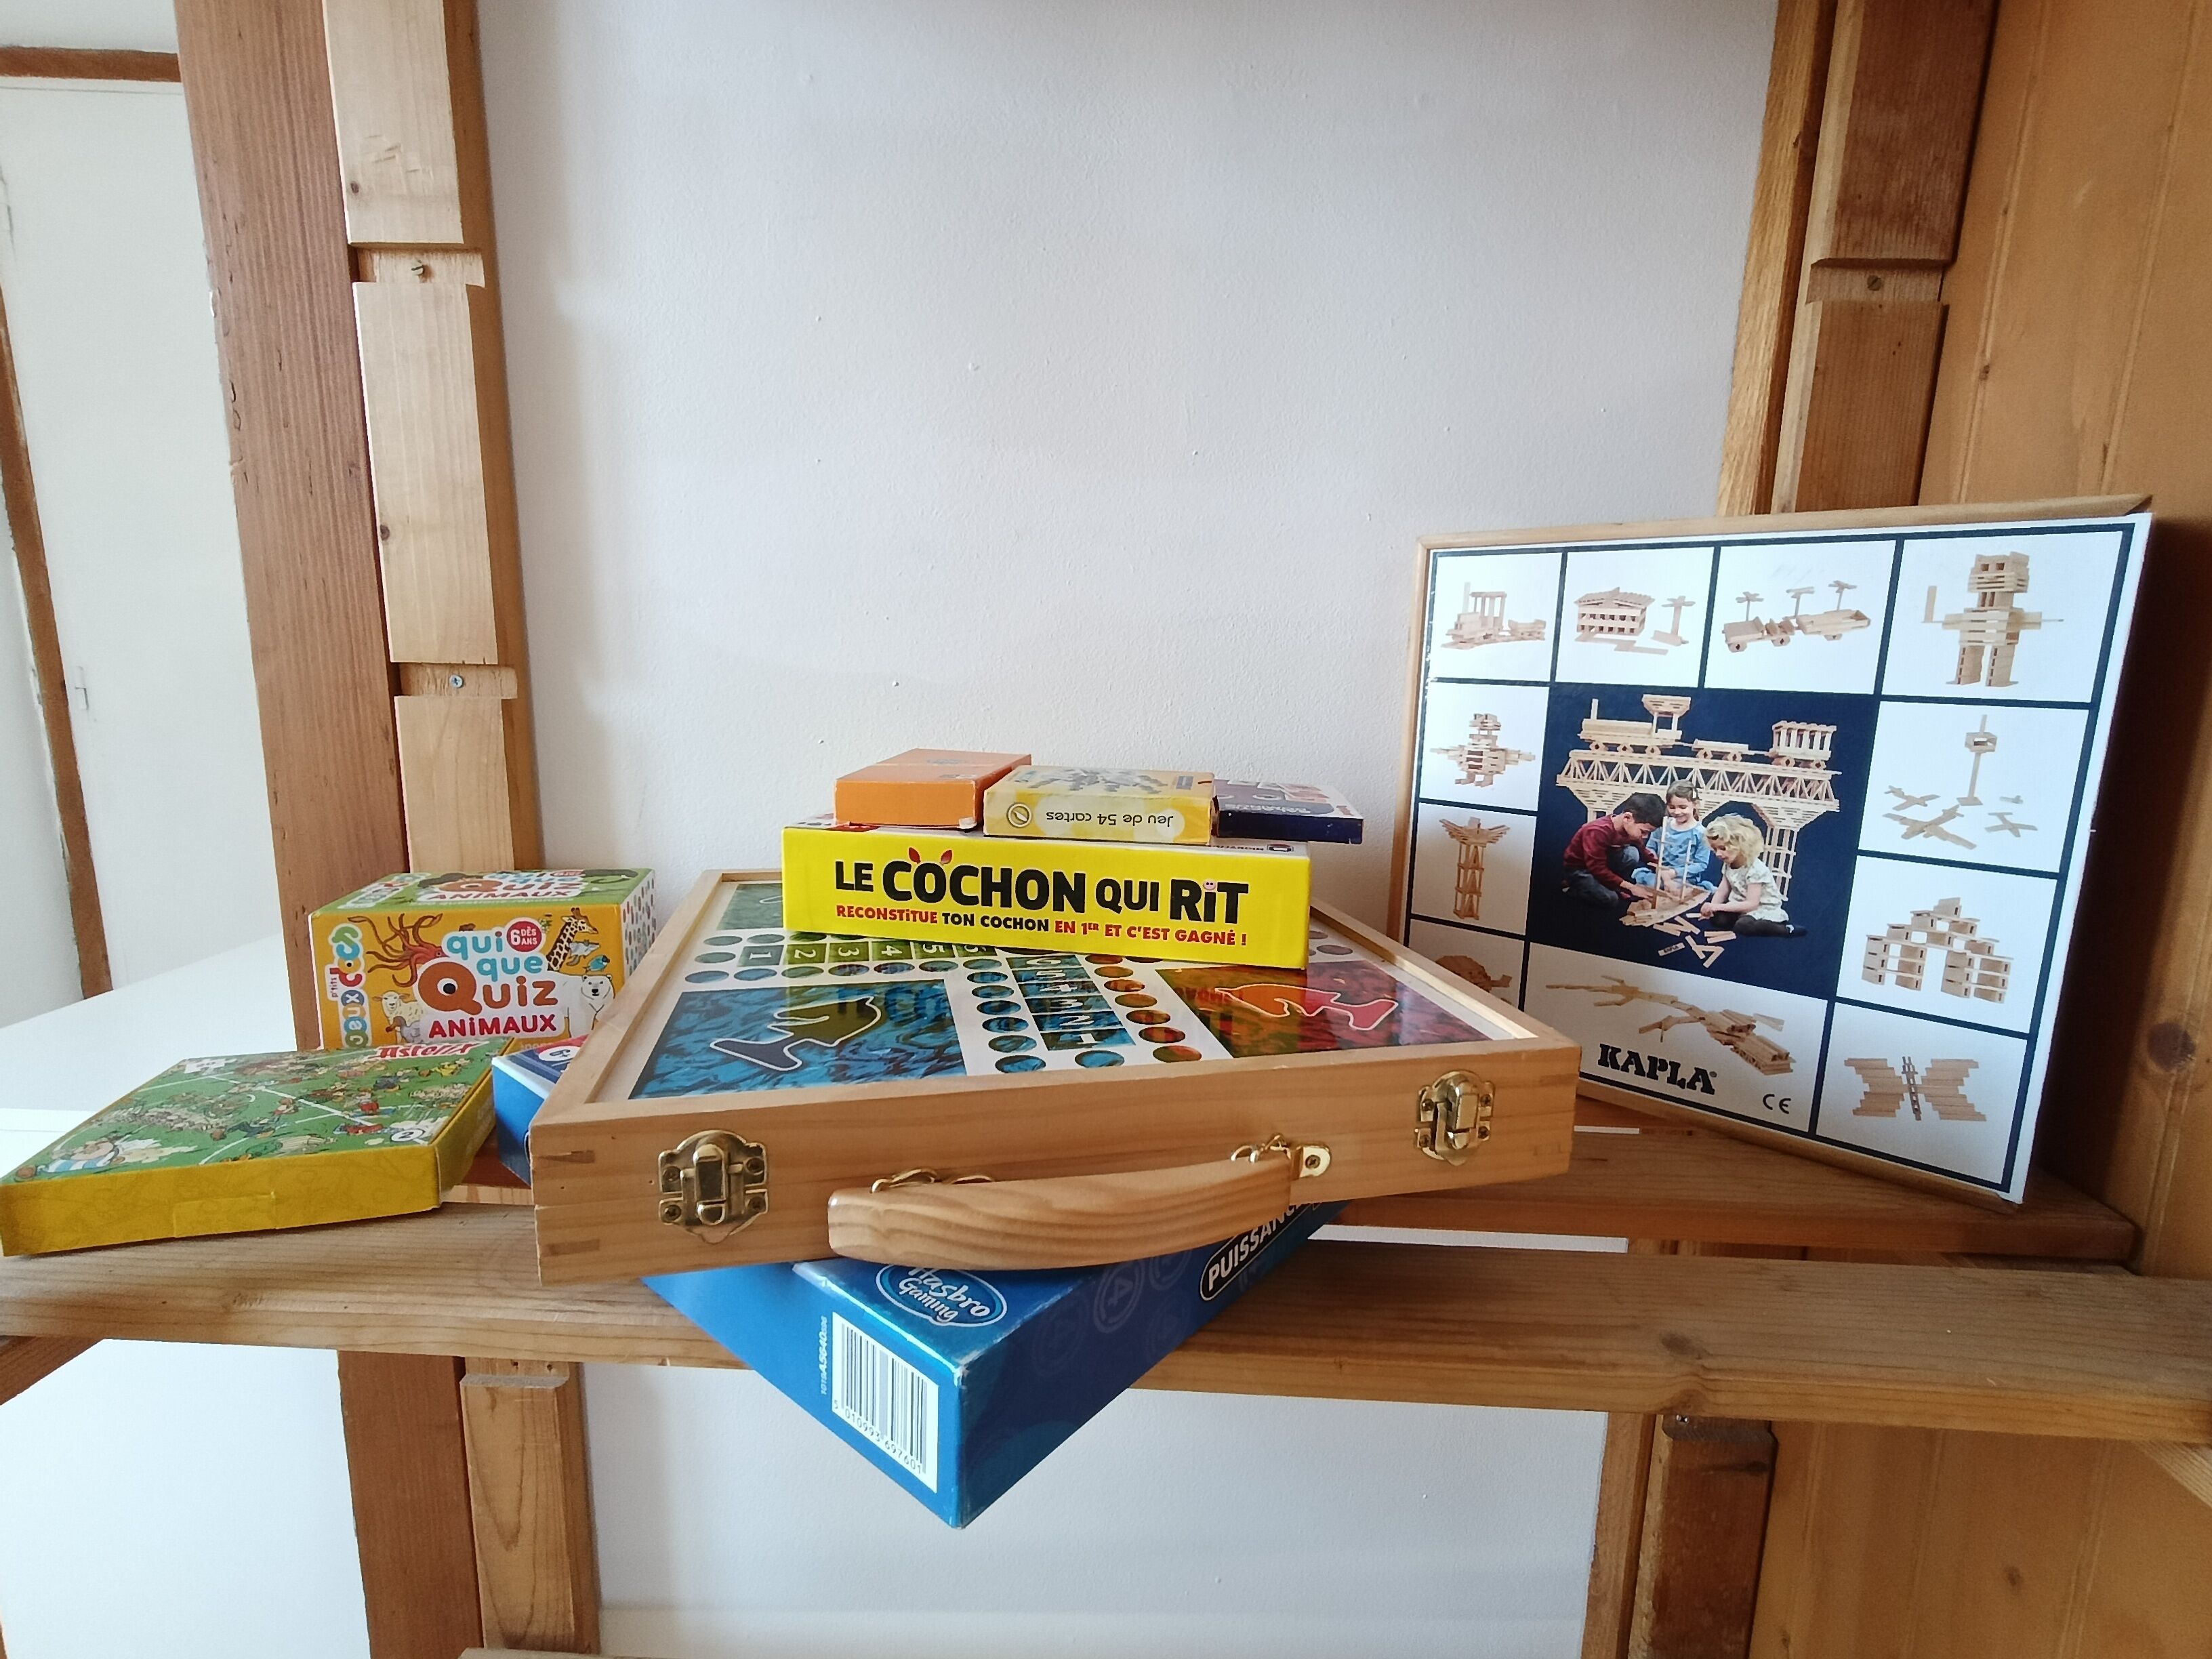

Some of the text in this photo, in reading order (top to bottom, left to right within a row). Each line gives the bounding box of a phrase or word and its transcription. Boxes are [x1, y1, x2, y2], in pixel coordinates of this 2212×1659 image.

[1046, 811, 1174, 827] Jeu de 54 cartes
[835, 861, 874, 892] LE
[882, 860, 1086, 914] COCHON
[1095, 878, 1160, 914] QUI
[510, 929, 520, 945] 6
[520, 926, 537, 936] DÈS
[942, 912, 975, 926] TON
[980, 915, 1049, 932] COCHON
[1054, 920, 1076, 934] EN
[1105, 924, 1122, 937] ET
[1126, 926, 1170, 941] C'EST
[1174, 929, 1236, 945] GAGNÉ
[1241, 933, 1247, 946] !
[446, 931, 503, 960] qui
[521, 937, 537, 945] ANS
[794, 949, 817, 958] 2
[838, 947, 860, 956] 3
[881, 945, 905, 956] 4
[476, 956, 543, 982] que
[1036, 969, 1066, 979] 5
[1050, 999, 1084, 1008] 3
[1059, 1015, 1095, 1026] 2
[1597, 1043, 1715, 1095] KAPLA
[1763, 1094, 1792, 1115] CE
[899, 1277, 959, 1323] Gaming
[907, 1267, 991, 1317] Hasbro
